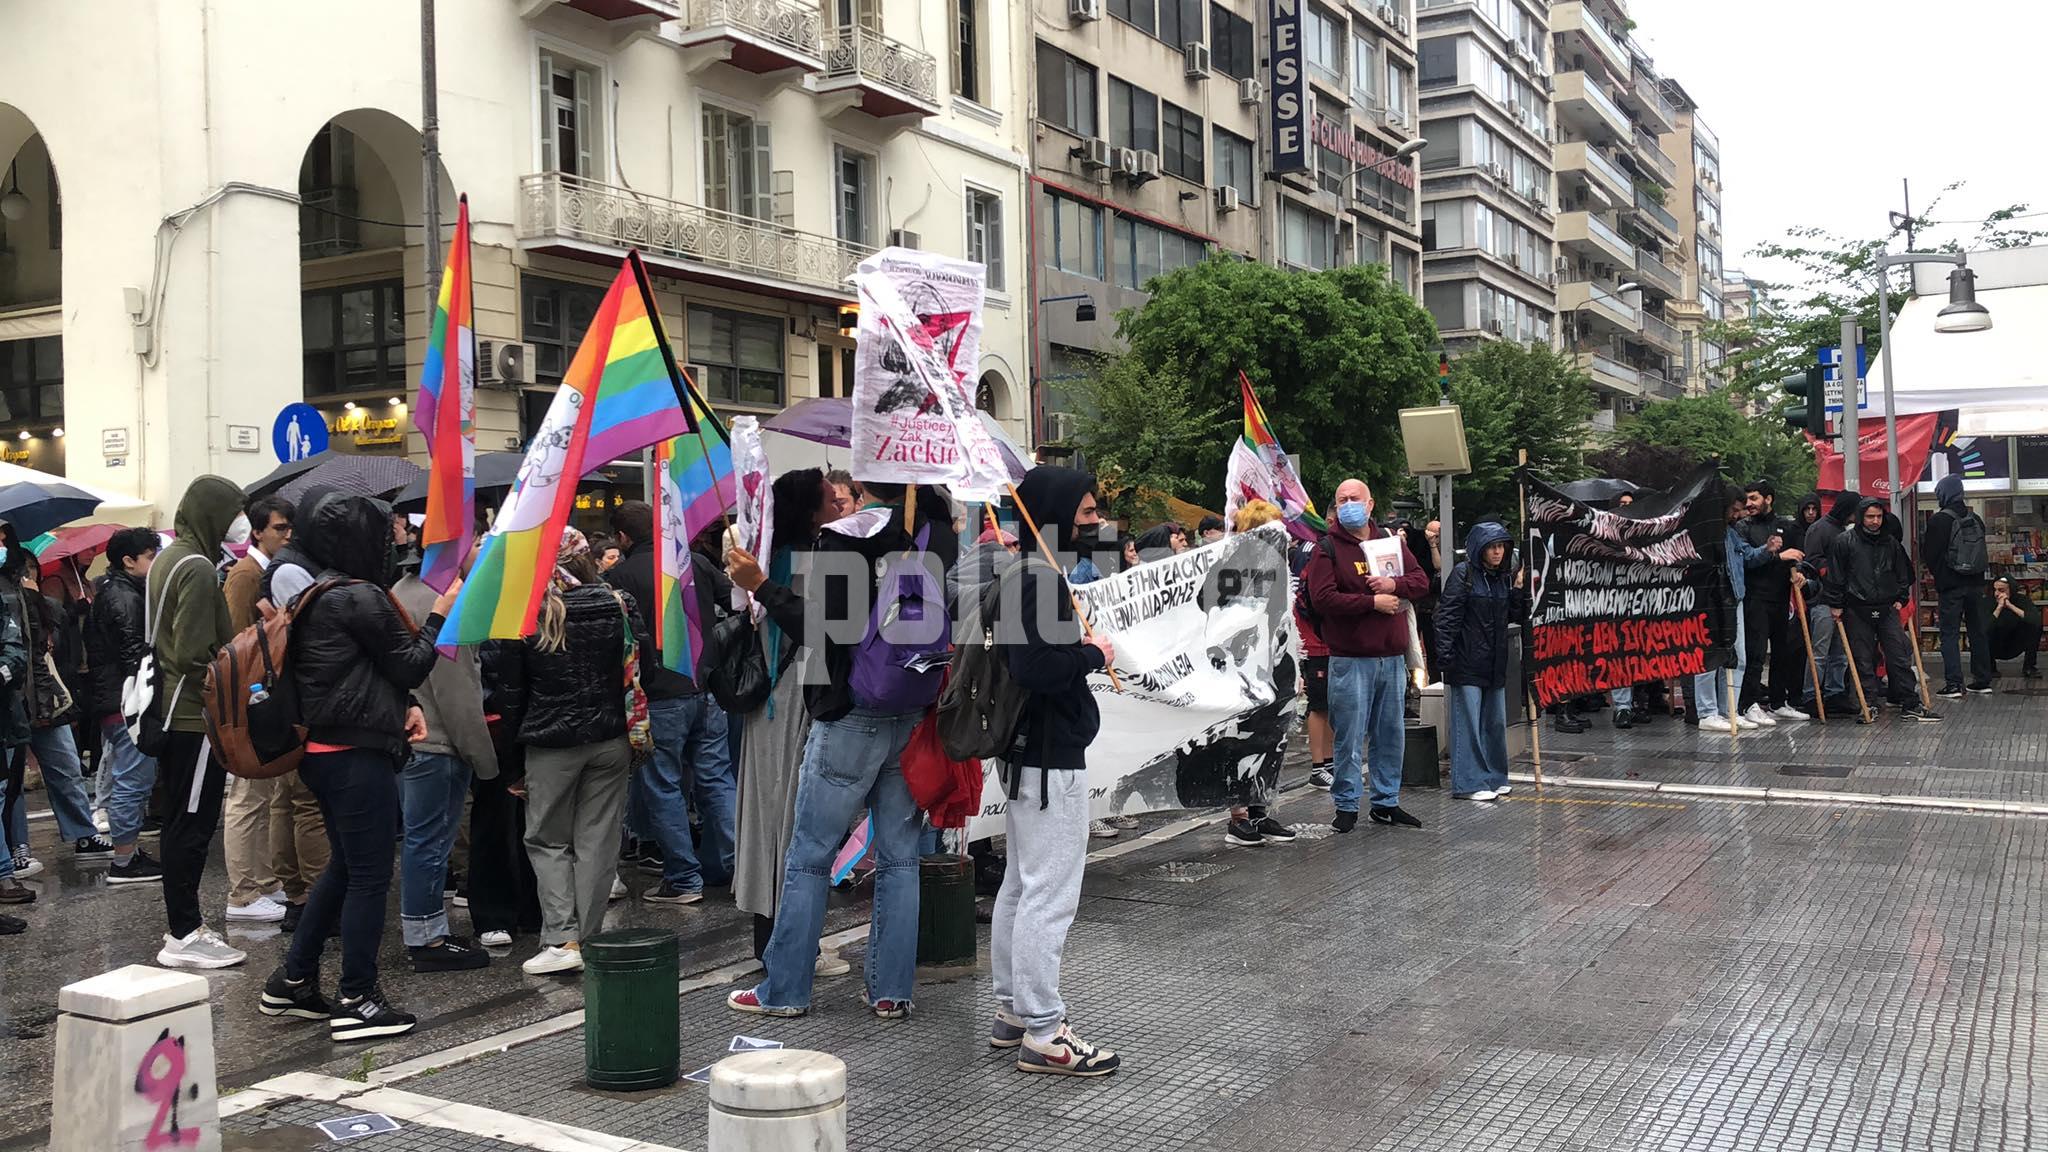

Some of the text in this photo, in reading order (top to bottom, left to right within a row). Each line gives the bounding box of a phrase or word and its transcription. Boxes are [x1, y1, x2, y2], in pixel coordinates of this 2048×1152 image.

[1321, 120, 1355, 162] CLINIC
[875, 434, 961, 466] Zackie
[900, 429, 922, 442] Zak
